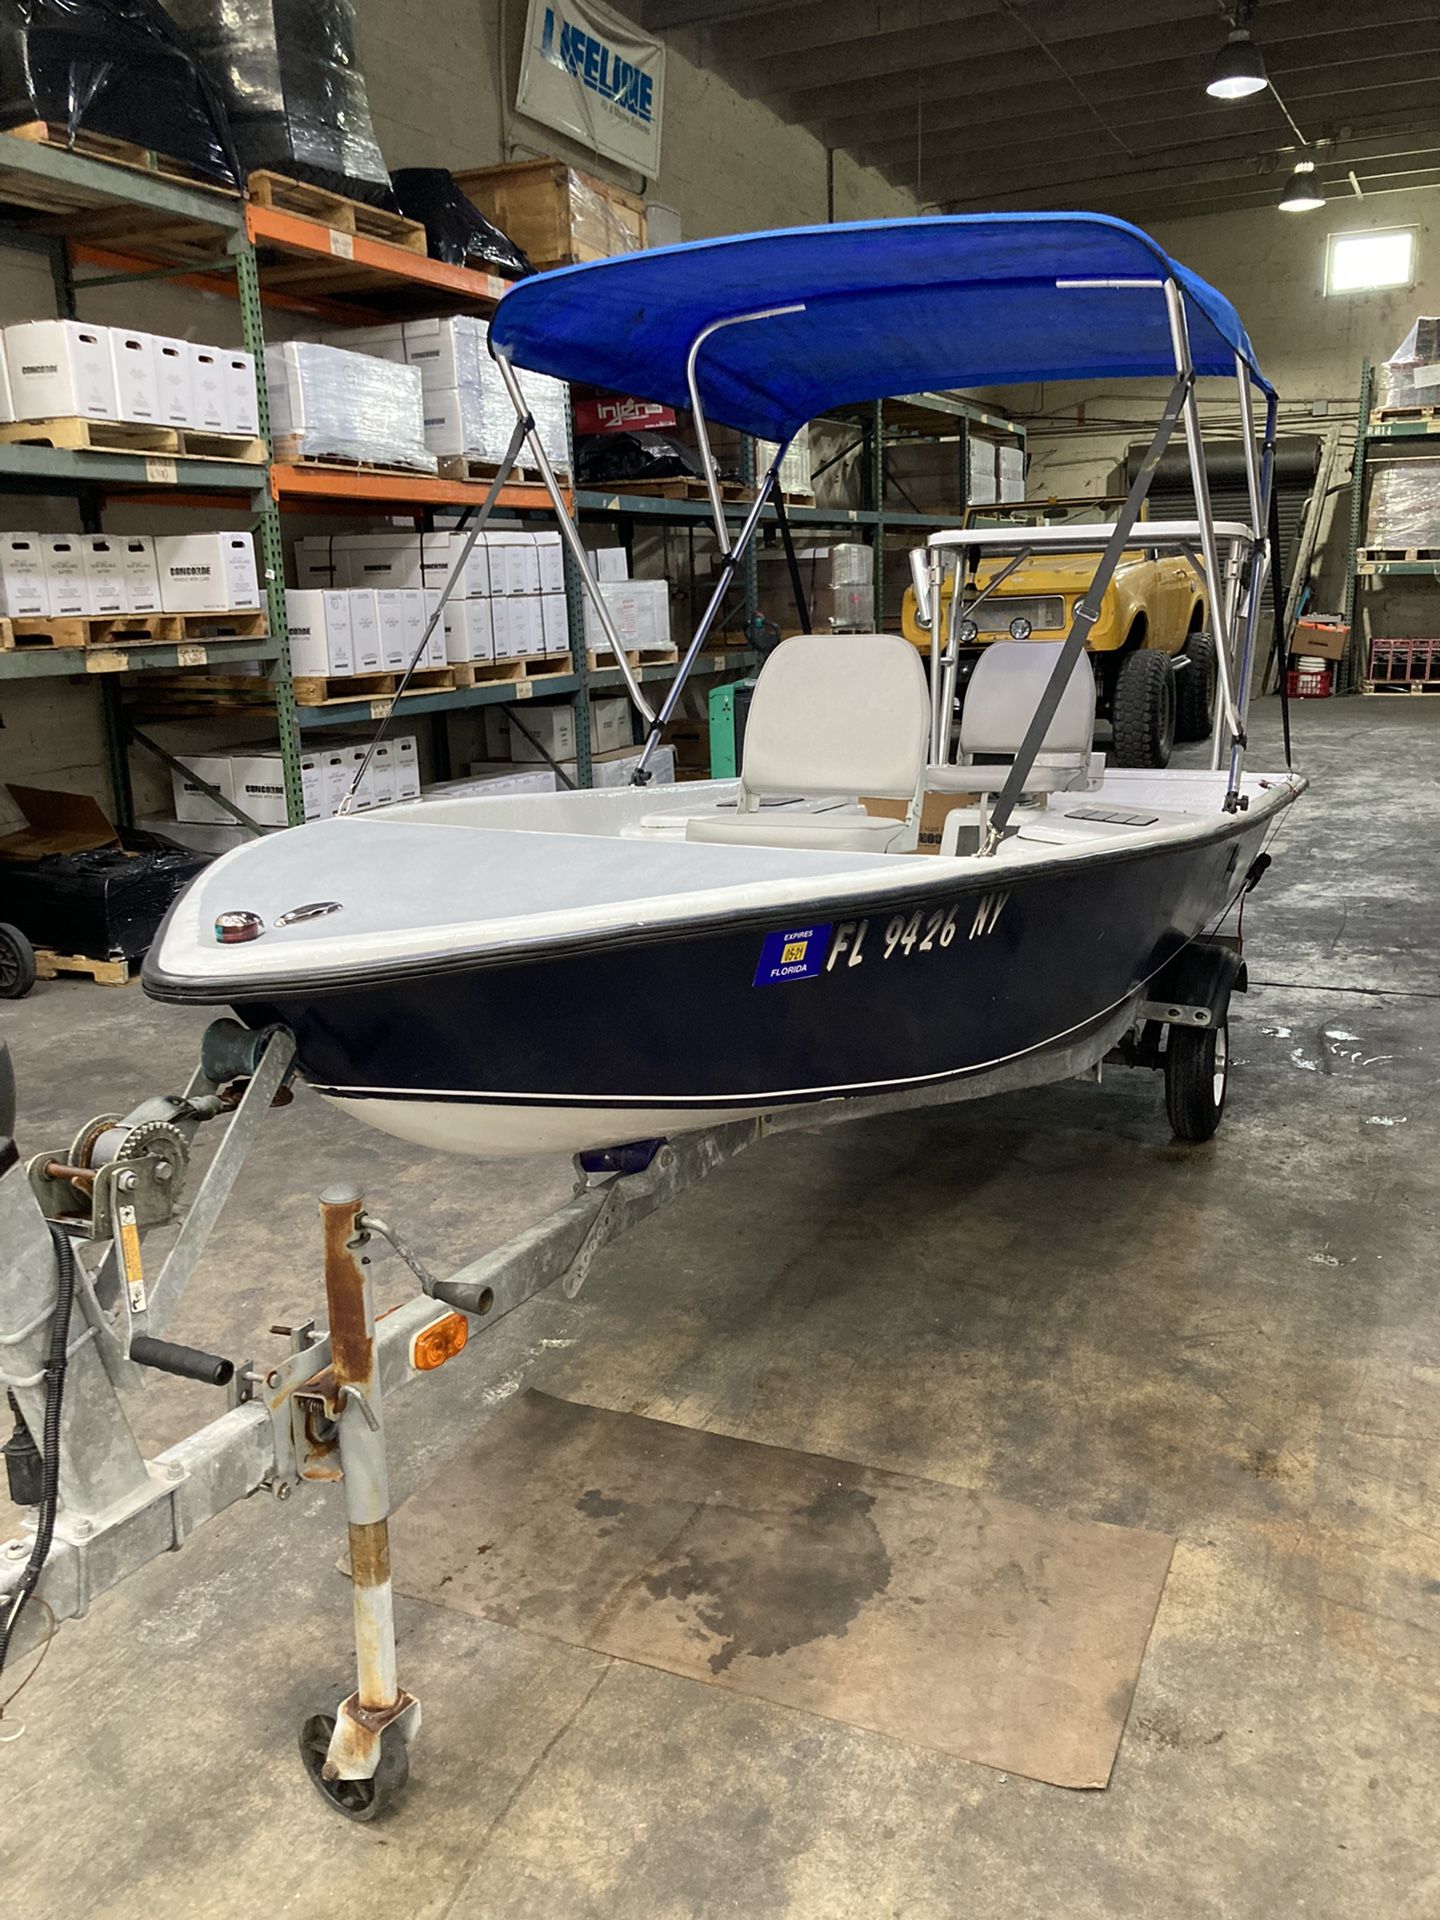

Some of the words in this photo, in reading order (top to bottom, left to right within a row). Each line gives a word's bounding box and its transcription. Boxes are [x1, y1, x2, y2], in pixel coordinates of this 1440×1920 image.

[170, 566, 211, 576] CONCORDE
[245, 785, 284, 794] CONCORDE
[784, 930, 814, 941] EXPIRES
[826, 919, 869, 972] FL
[884, 904, 960, 960] 9426
[968, 890, 1012, 941] NY
[770, 964, 807, 977] FLORIDA
